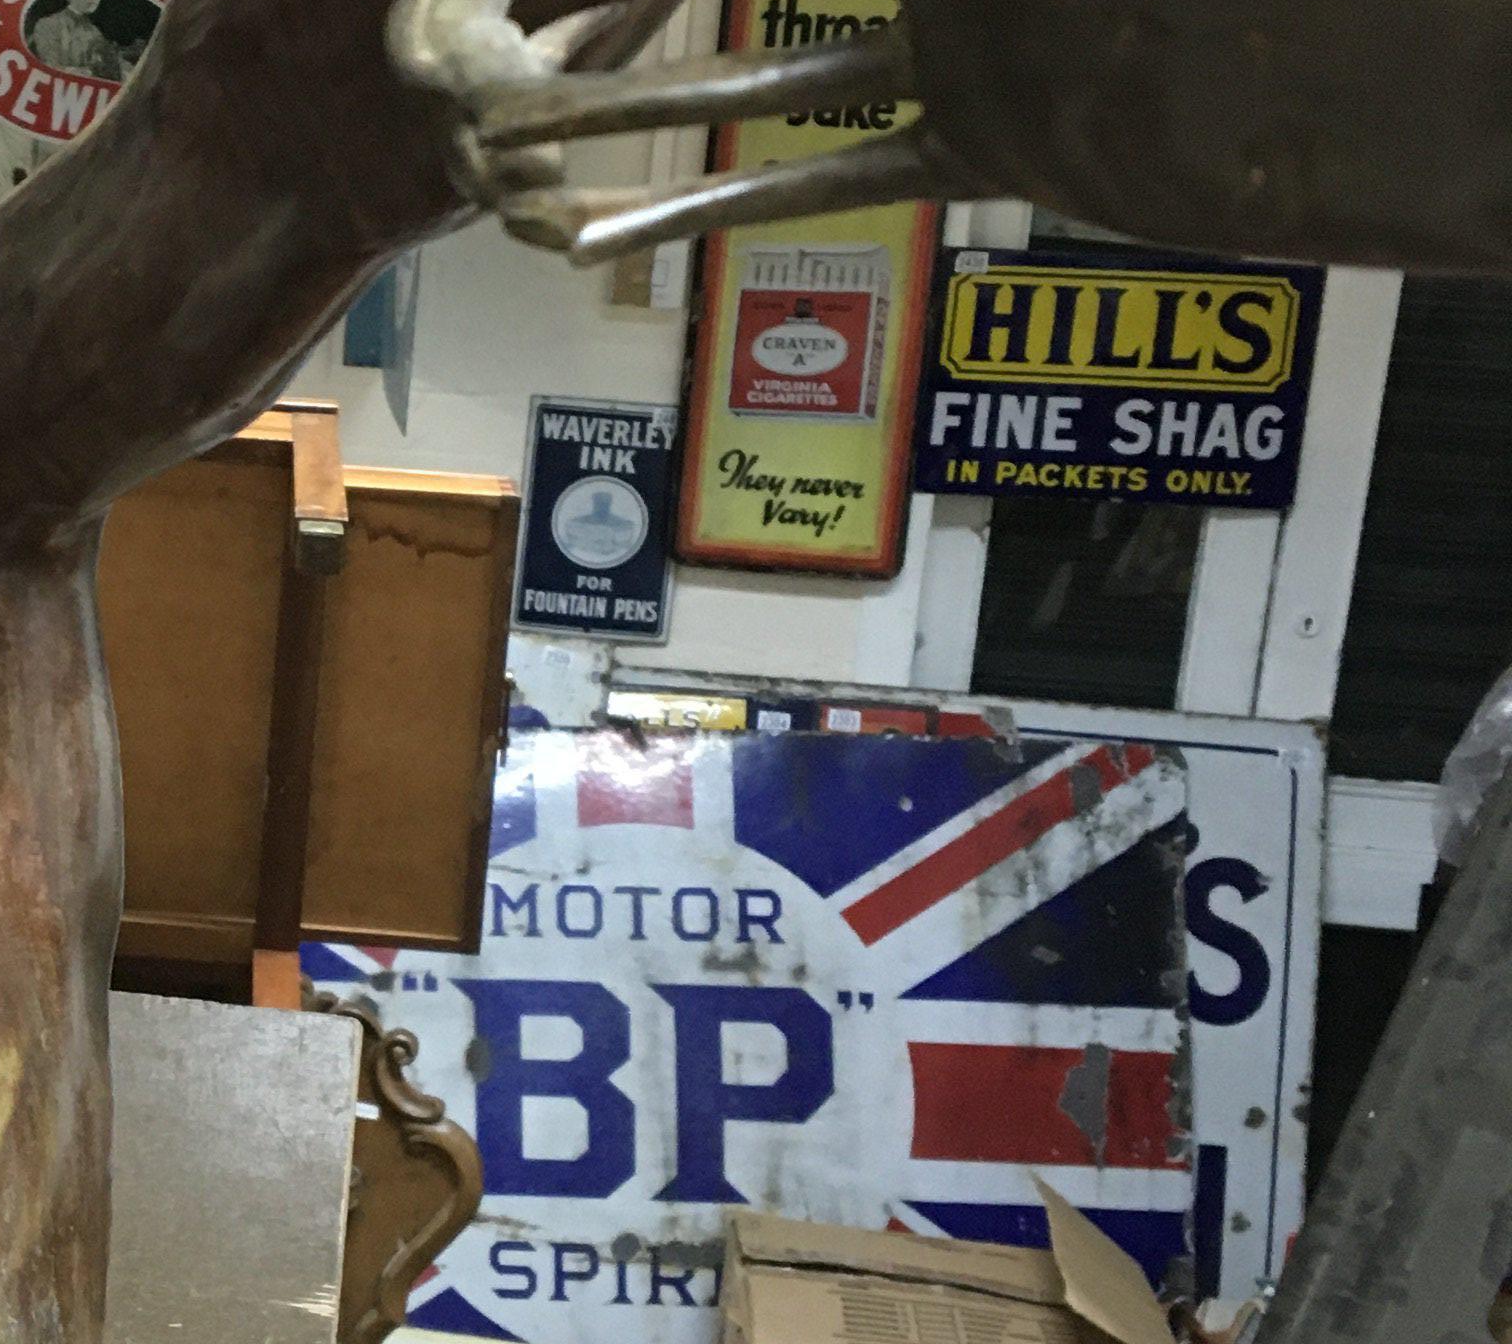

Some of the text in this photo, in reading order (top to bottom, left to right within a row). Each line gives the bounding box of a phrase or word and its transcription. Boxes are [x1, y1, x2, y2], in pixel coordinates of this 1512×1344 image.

[762, 337, 836, 351] CRAVEN
[963, 282, 1274, 374] HILL'S
[541, 412, 676, 451] WAVERLEY
[929, 391, 1286, 462] FINE SHAG
[579, 445, 636, 474] INK
[718, 448, 865, 499] They never
[945, 459, 979, 483] IN
[995, 461, 1149, 491] PACKETS
[761, 499, 846, 537] Vary!
[576, 573, 613, 592] FOR
[523, 589, 659, 623] FOUNTAIN PENS
[488, 881, 786, 945] MOTOR
